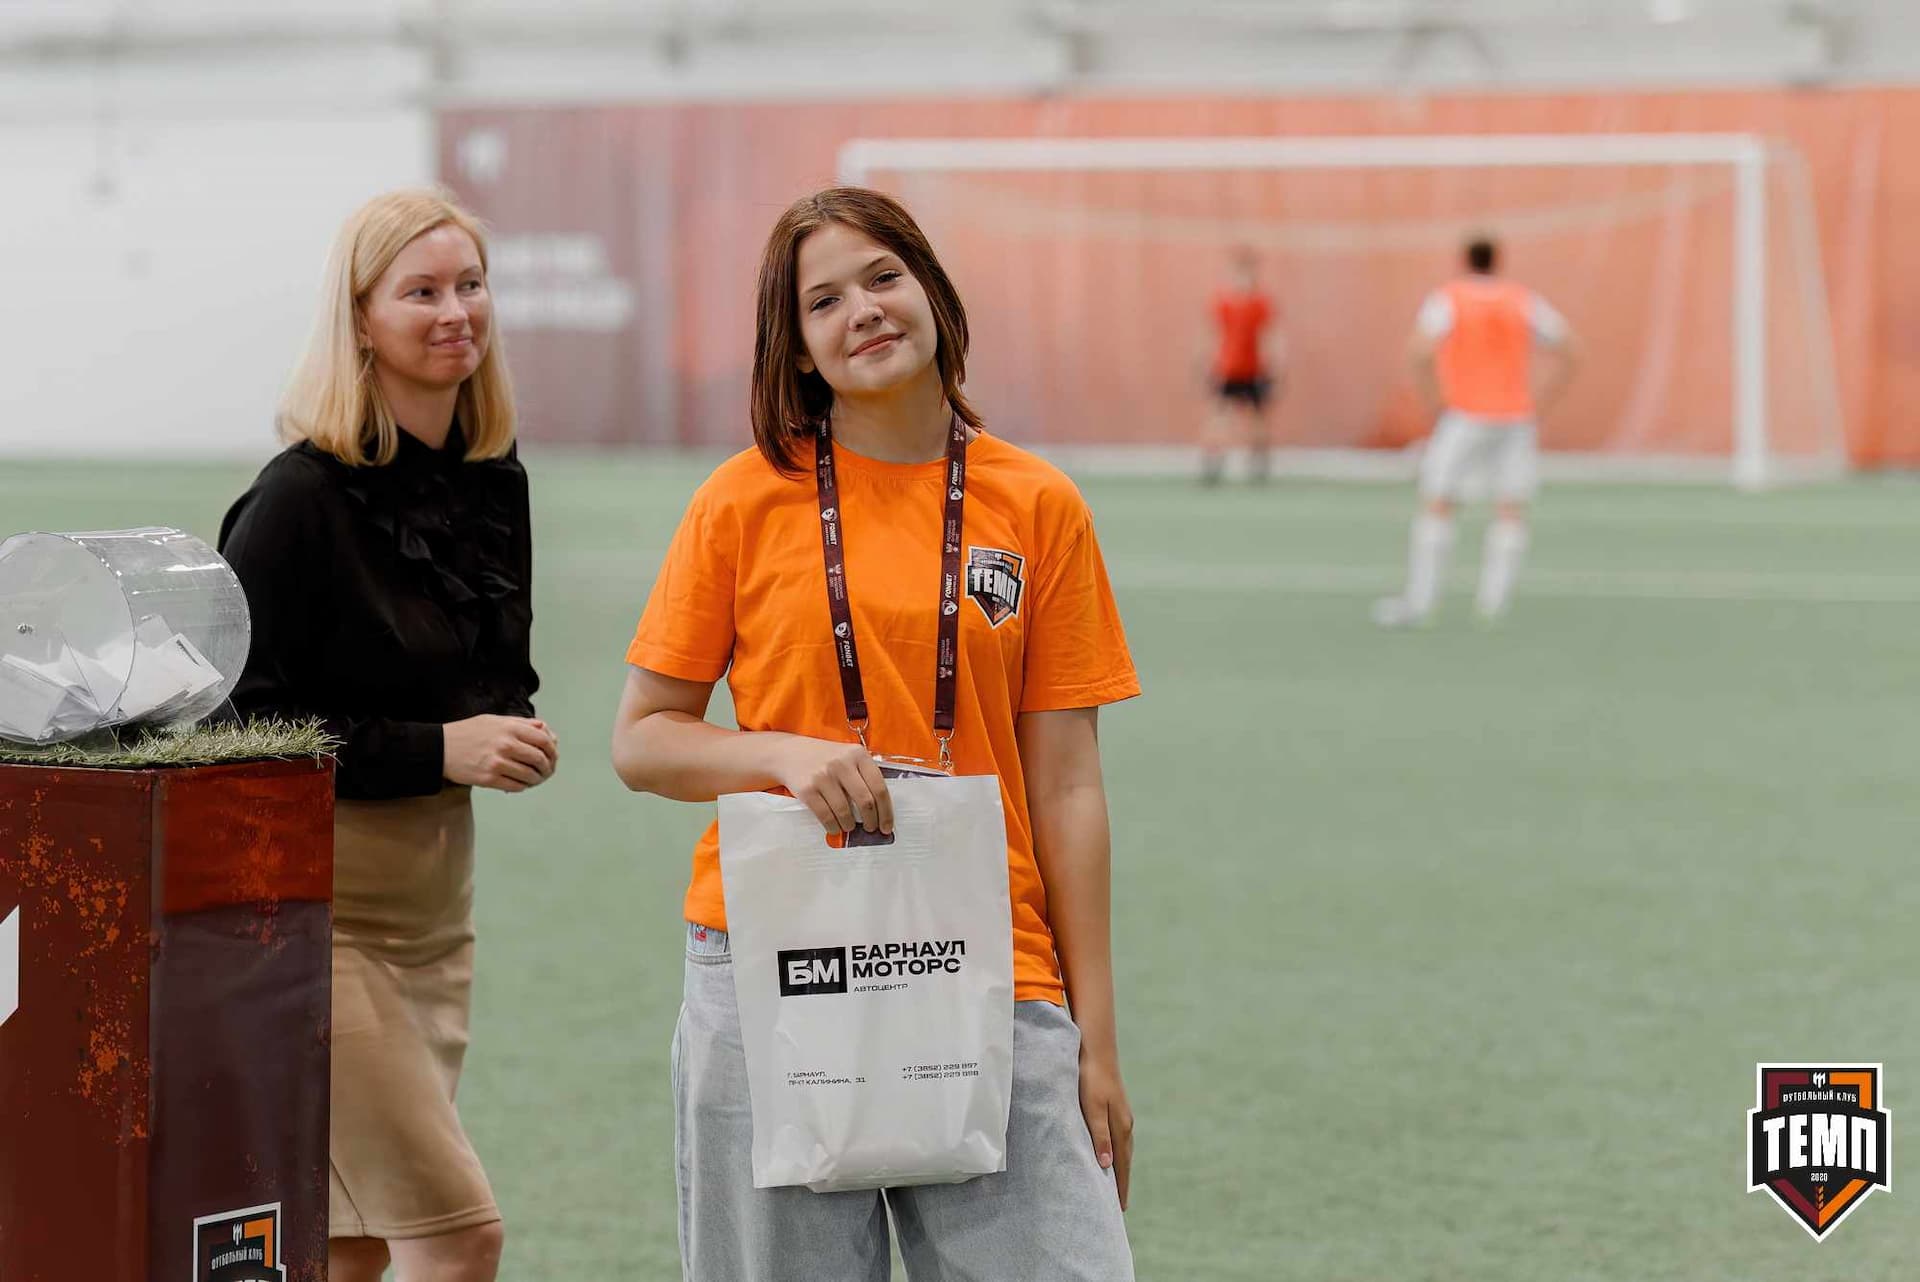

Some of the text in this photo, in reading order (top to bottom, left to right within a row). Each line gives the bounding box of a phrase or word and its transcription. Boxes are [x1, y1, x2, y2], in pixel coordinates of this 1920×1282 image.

[971, 568, 1018, 609] ТЕМП
[851, 940, 966, 961] БАРНАУЛ
[787, 958, 840, 986] БМ
[852, 958, 961, 979] МОТОРС
[853, 983, 909, 993] АВТОЦЕНТР
